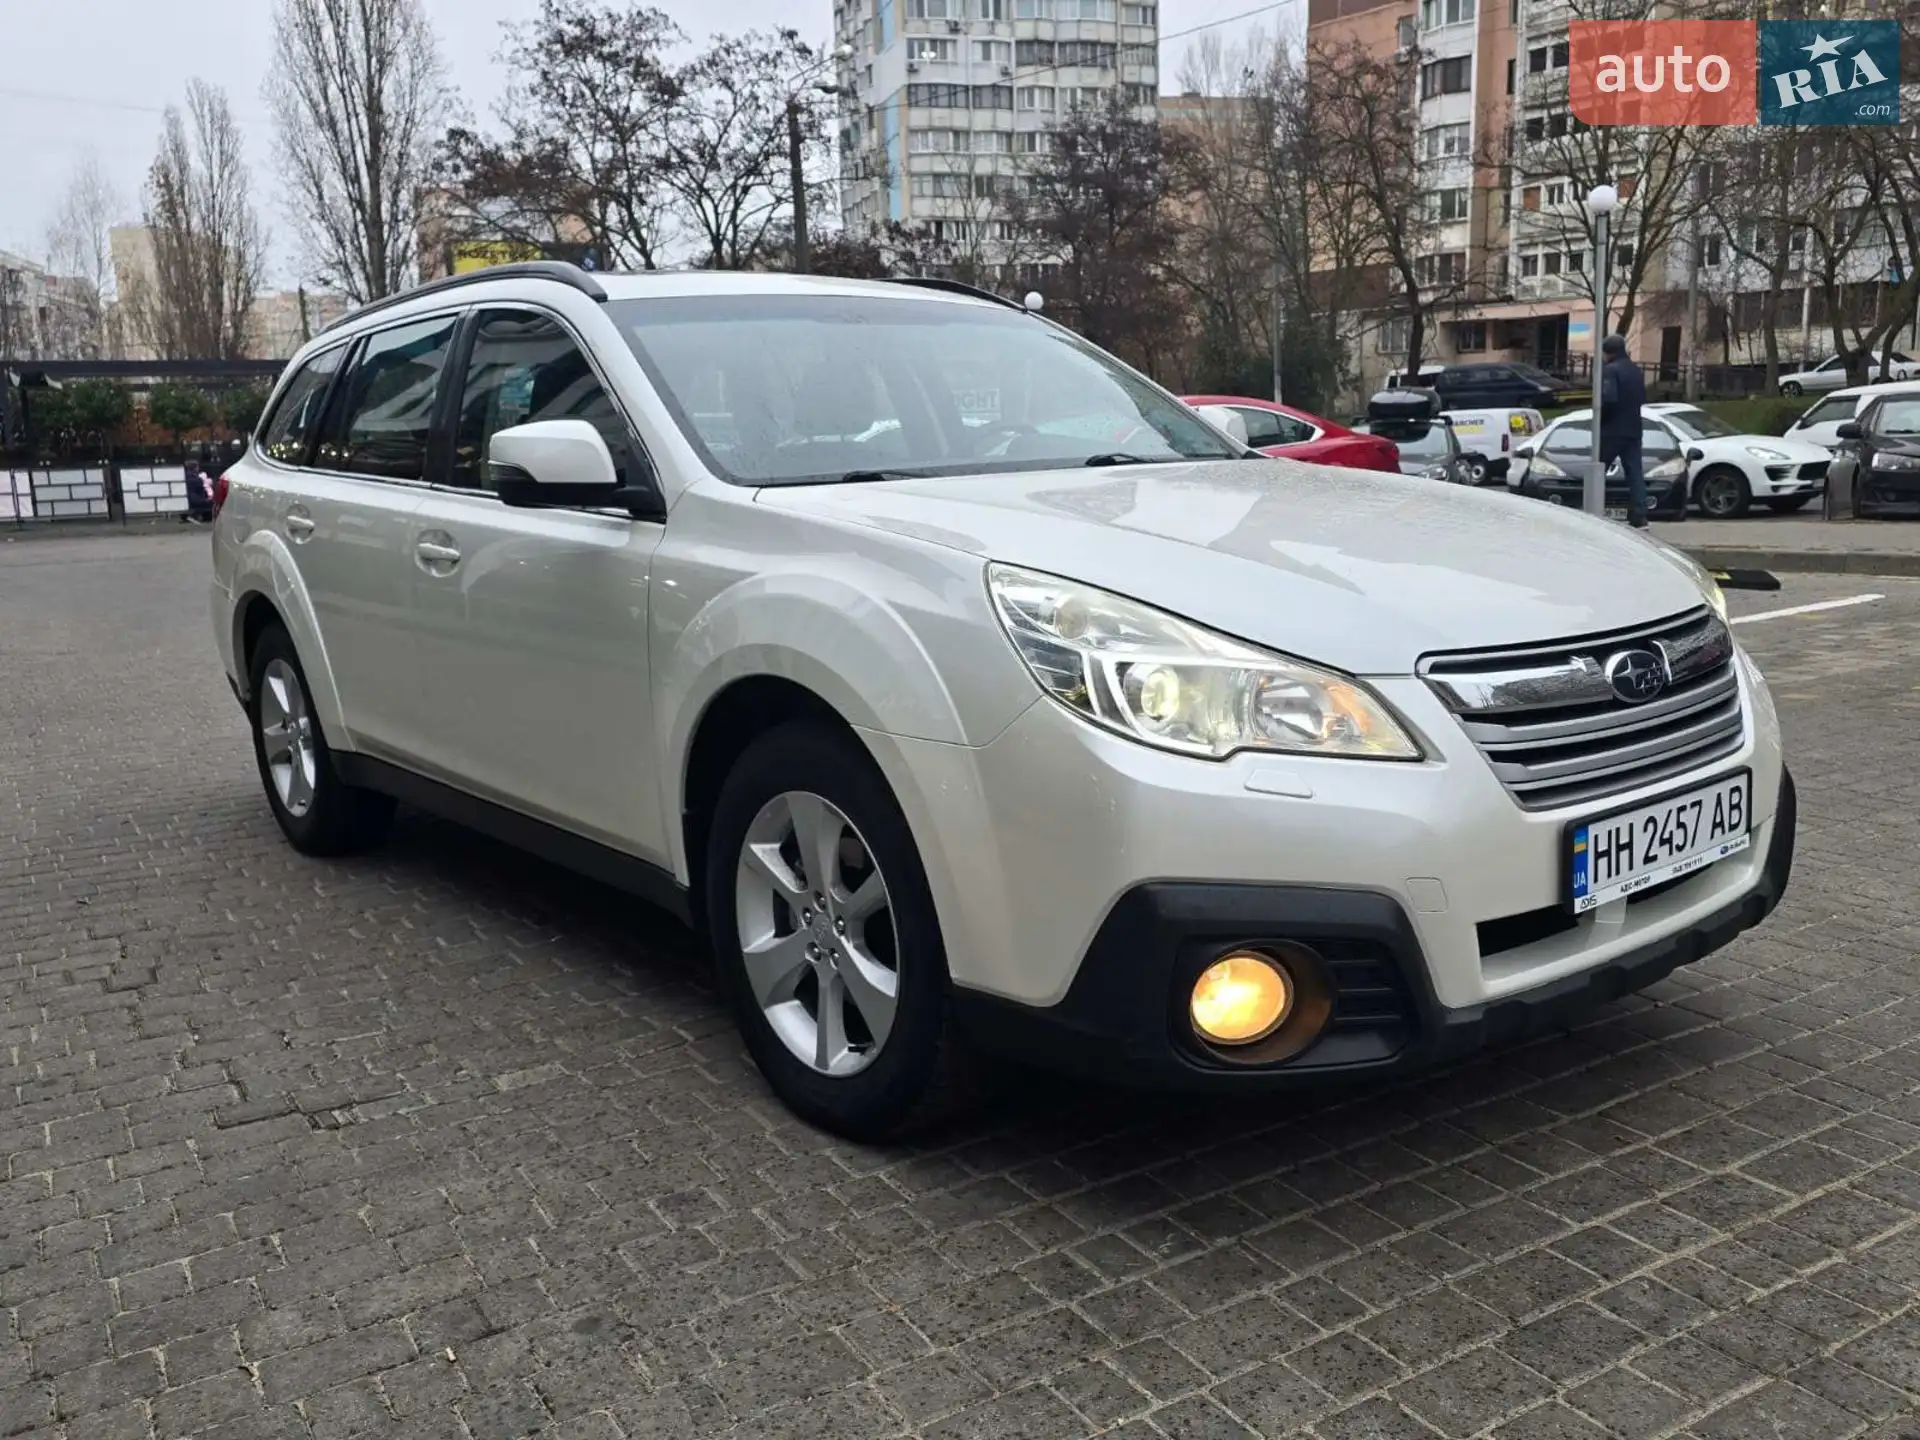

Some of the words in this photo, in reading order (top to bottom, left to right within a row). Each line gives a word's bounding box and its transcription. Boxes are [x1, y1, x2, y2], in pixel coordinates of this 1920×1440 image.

[1593, 822, 1634, 884] HH
[1643, 799, 1703, 866] 2457
[1710, 785, 1743, 841] AB
[1573, 871, 1588, 889] UA
